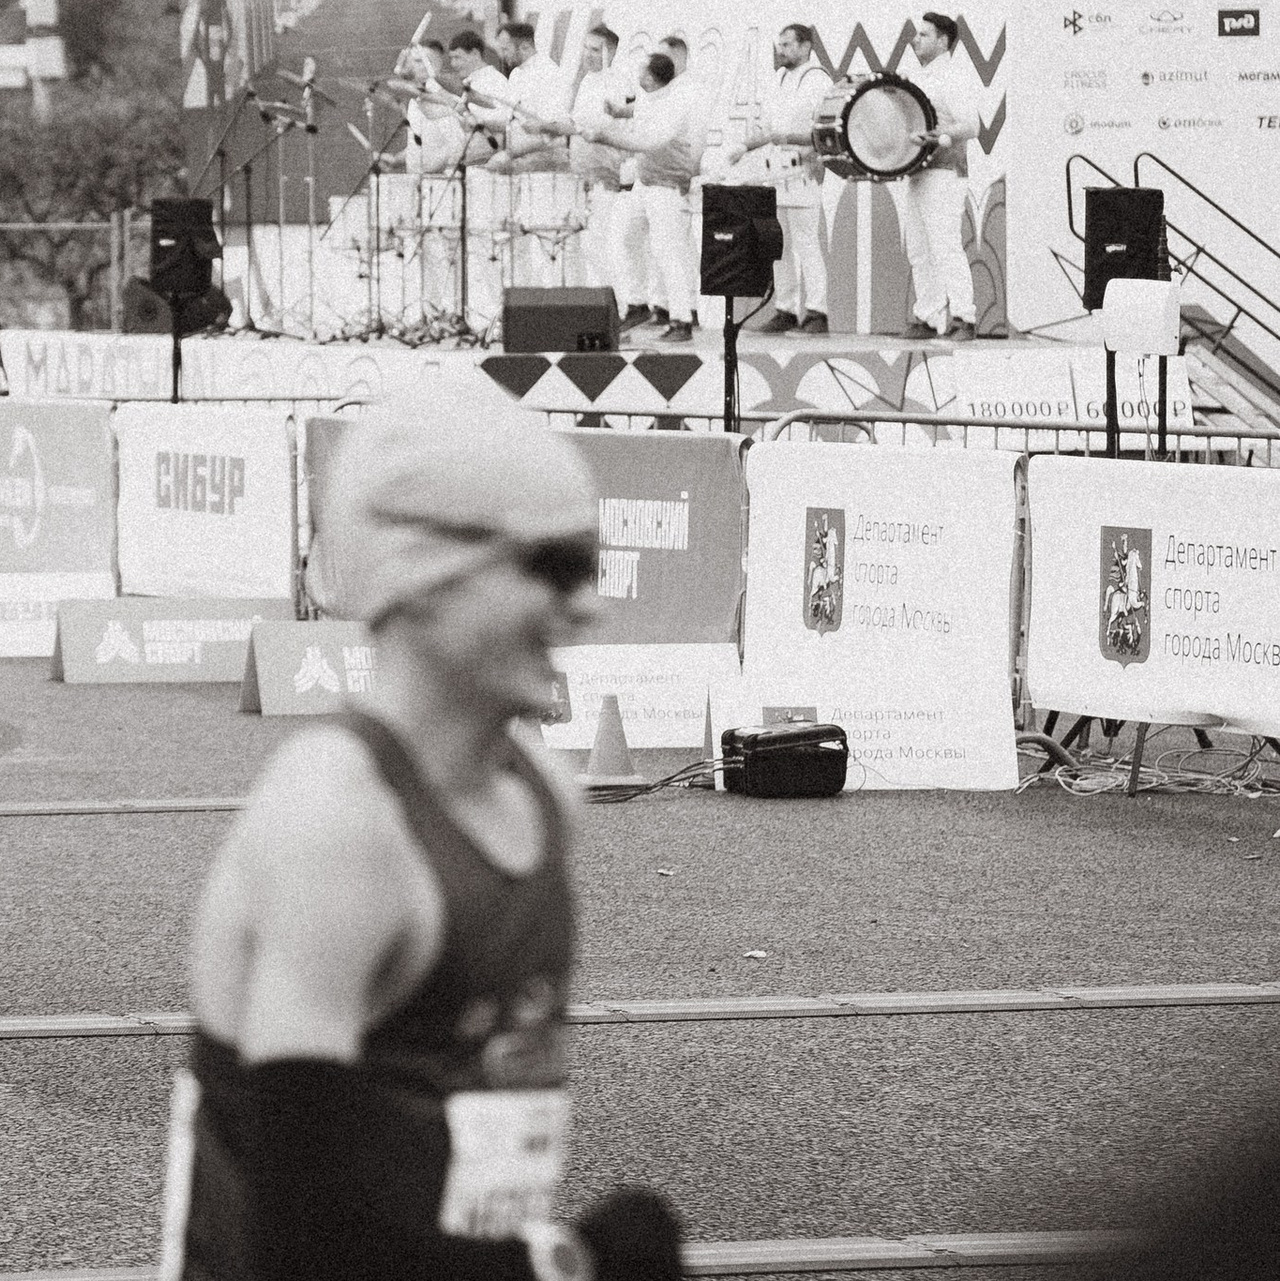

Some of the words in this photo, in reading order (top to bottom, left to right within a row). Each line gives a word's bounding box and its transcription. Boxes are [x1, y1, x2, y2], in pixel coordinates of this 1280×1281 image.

[155, 451, 245, 516] СИБУР
[853, 513, 945, 547] Департамент
[1164, 534, 1277, 576] Департамент
[854, 562, 899, 594] спорта
[853, 604, 896, 633] города
[900, 602, 954, 634] Москвы
[1164, 587, 1220, 621] спорта
[1164, 632, 1221, 666] города
[831, 707, 945, 725] Департамент
[898, 745, 967, 761] Москвы
